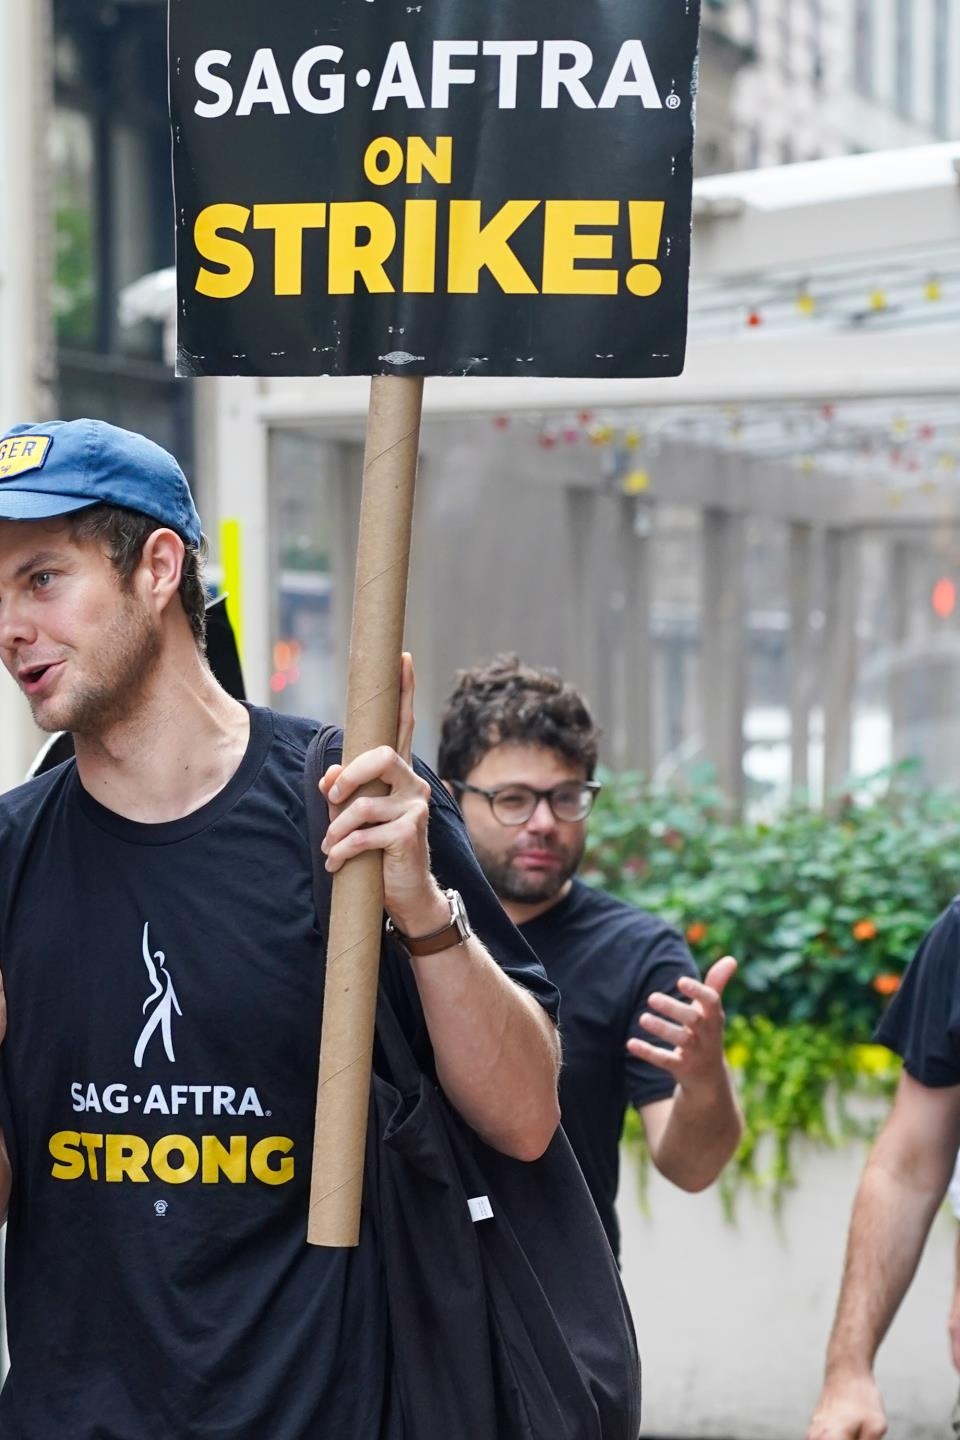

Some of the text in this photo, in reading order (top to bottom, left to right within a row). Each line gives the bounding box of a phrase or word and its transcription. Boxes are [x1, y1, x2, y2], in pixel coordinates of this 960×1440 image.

[363, 136, 453, 186] ON
[193, 199, 666, 299] STRIKE!
[48, 1130, 296, 1186] STRONG
